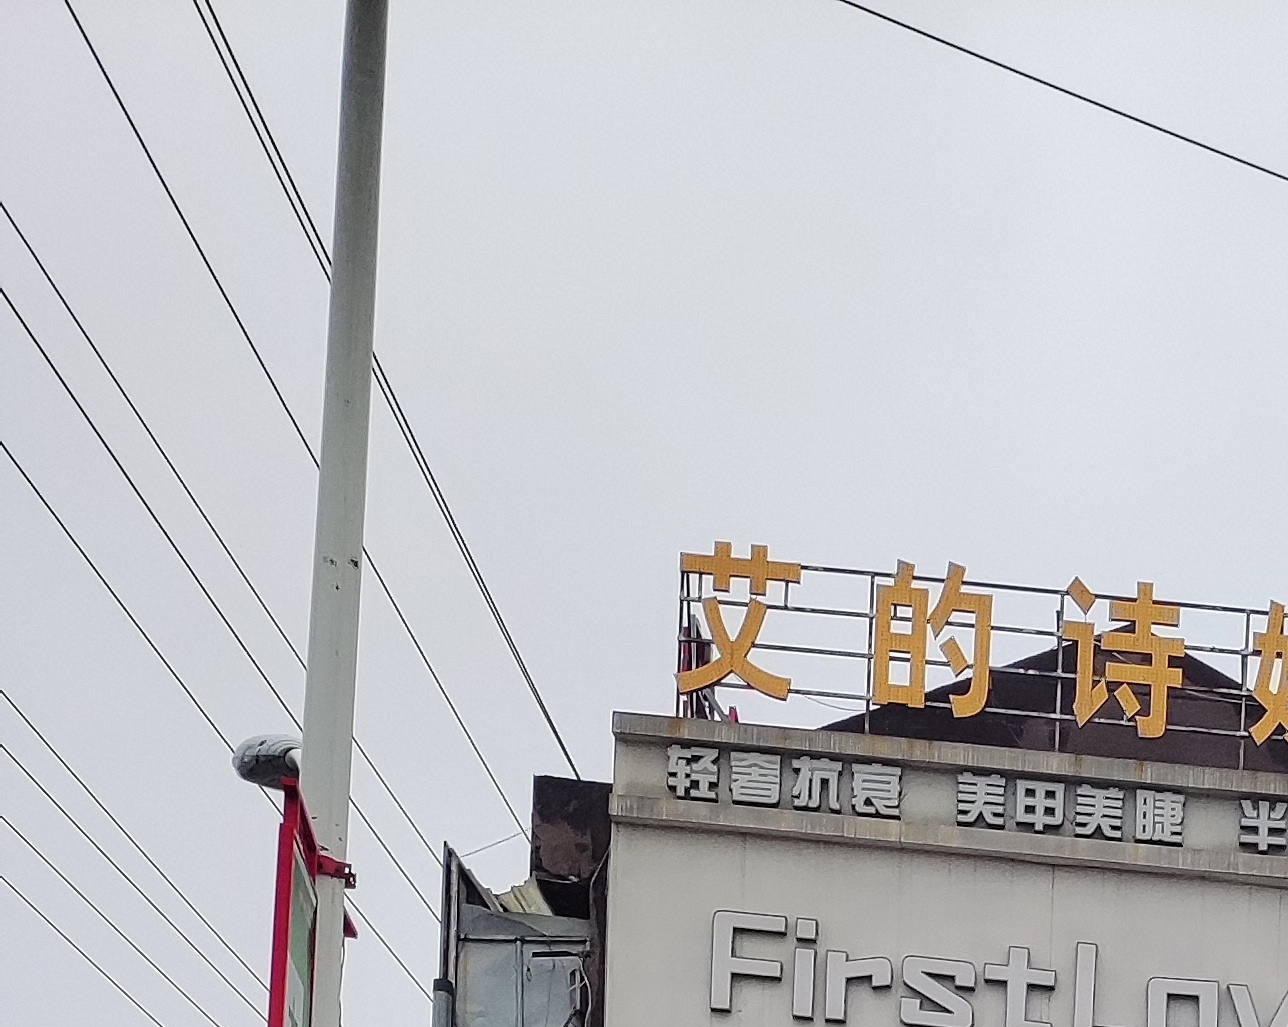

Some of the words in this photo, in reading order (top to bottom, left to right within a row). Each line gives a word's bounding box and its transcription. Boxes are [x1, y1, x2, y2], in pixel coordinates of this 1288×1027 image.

[667, 744, 901, 818] 轻奢抗衰
[956, 772, 1185, 846] 美甲美睫
